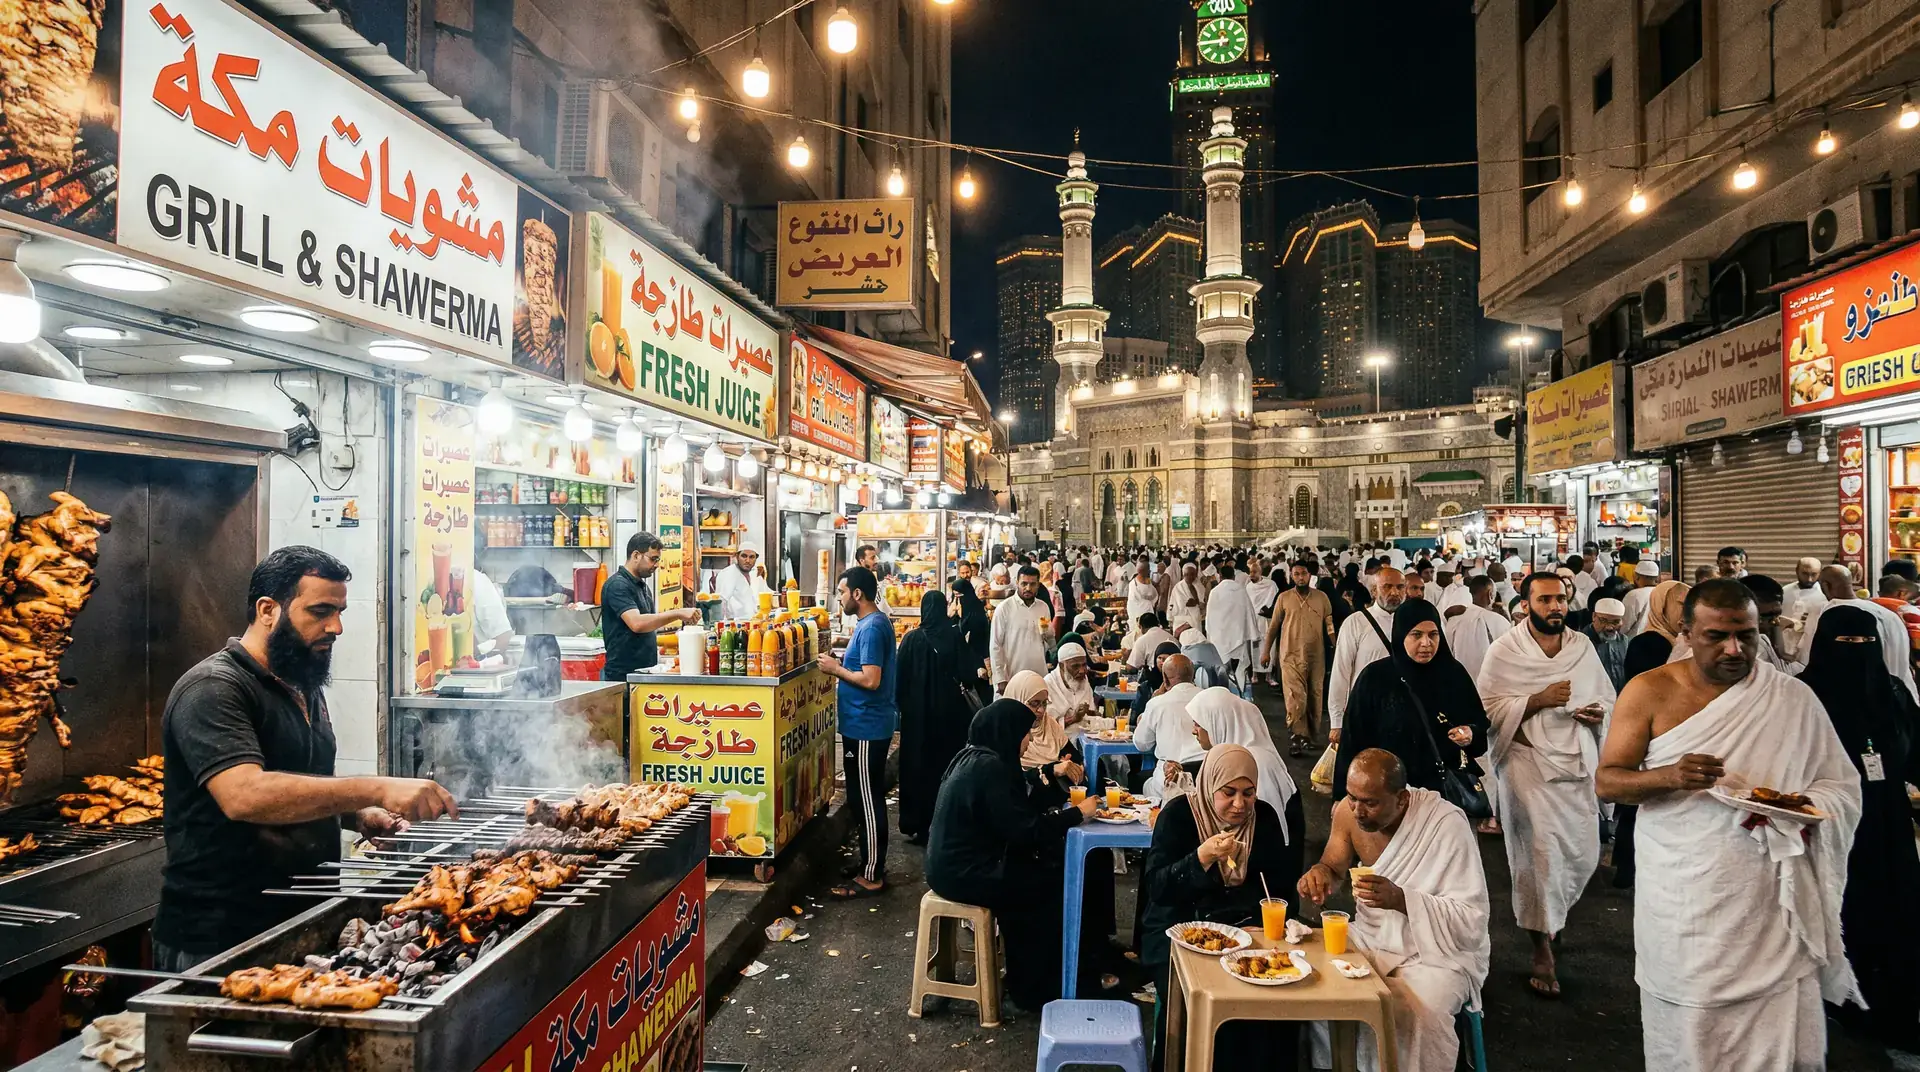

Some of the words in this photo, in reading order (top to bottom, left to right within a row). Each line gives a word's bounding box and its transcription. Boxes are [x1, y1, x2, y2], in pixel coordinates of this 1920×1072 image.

[149, 2, 300, 171] مكة
[318, 115, 506, 267] مشويات
[146, 173, 285, 276] GRILL
[297, 229, 324, 288] &
[334, 243, 503, 348] SHAWERMA
[788, 245, 902, 277] العريض
[629, 248, 704, 341] طازجة
[709, 304, 774, 377] عصيرات
[640, 340, 710, 412] FRESH
[715, 376, 762, 429] JUICE
[1845, 354, 1904, 389] GRIESH
[422, 435, 470, 464] عصيرات
[422, 469, 470, 498] عصيرات
[423, 502, 469, 534] طازجة
[643, 692, 765, 727] عصيرات
[780, 720, 809, 763] FRESH
[811, 703, 835, 740] JUICE
[649, 724, 758, 760] طازجة
[641, 764, 702, 784] FRESH
[708, 766, 765, 785] JUICE
[607, 891, 700, 1029] مشويات
